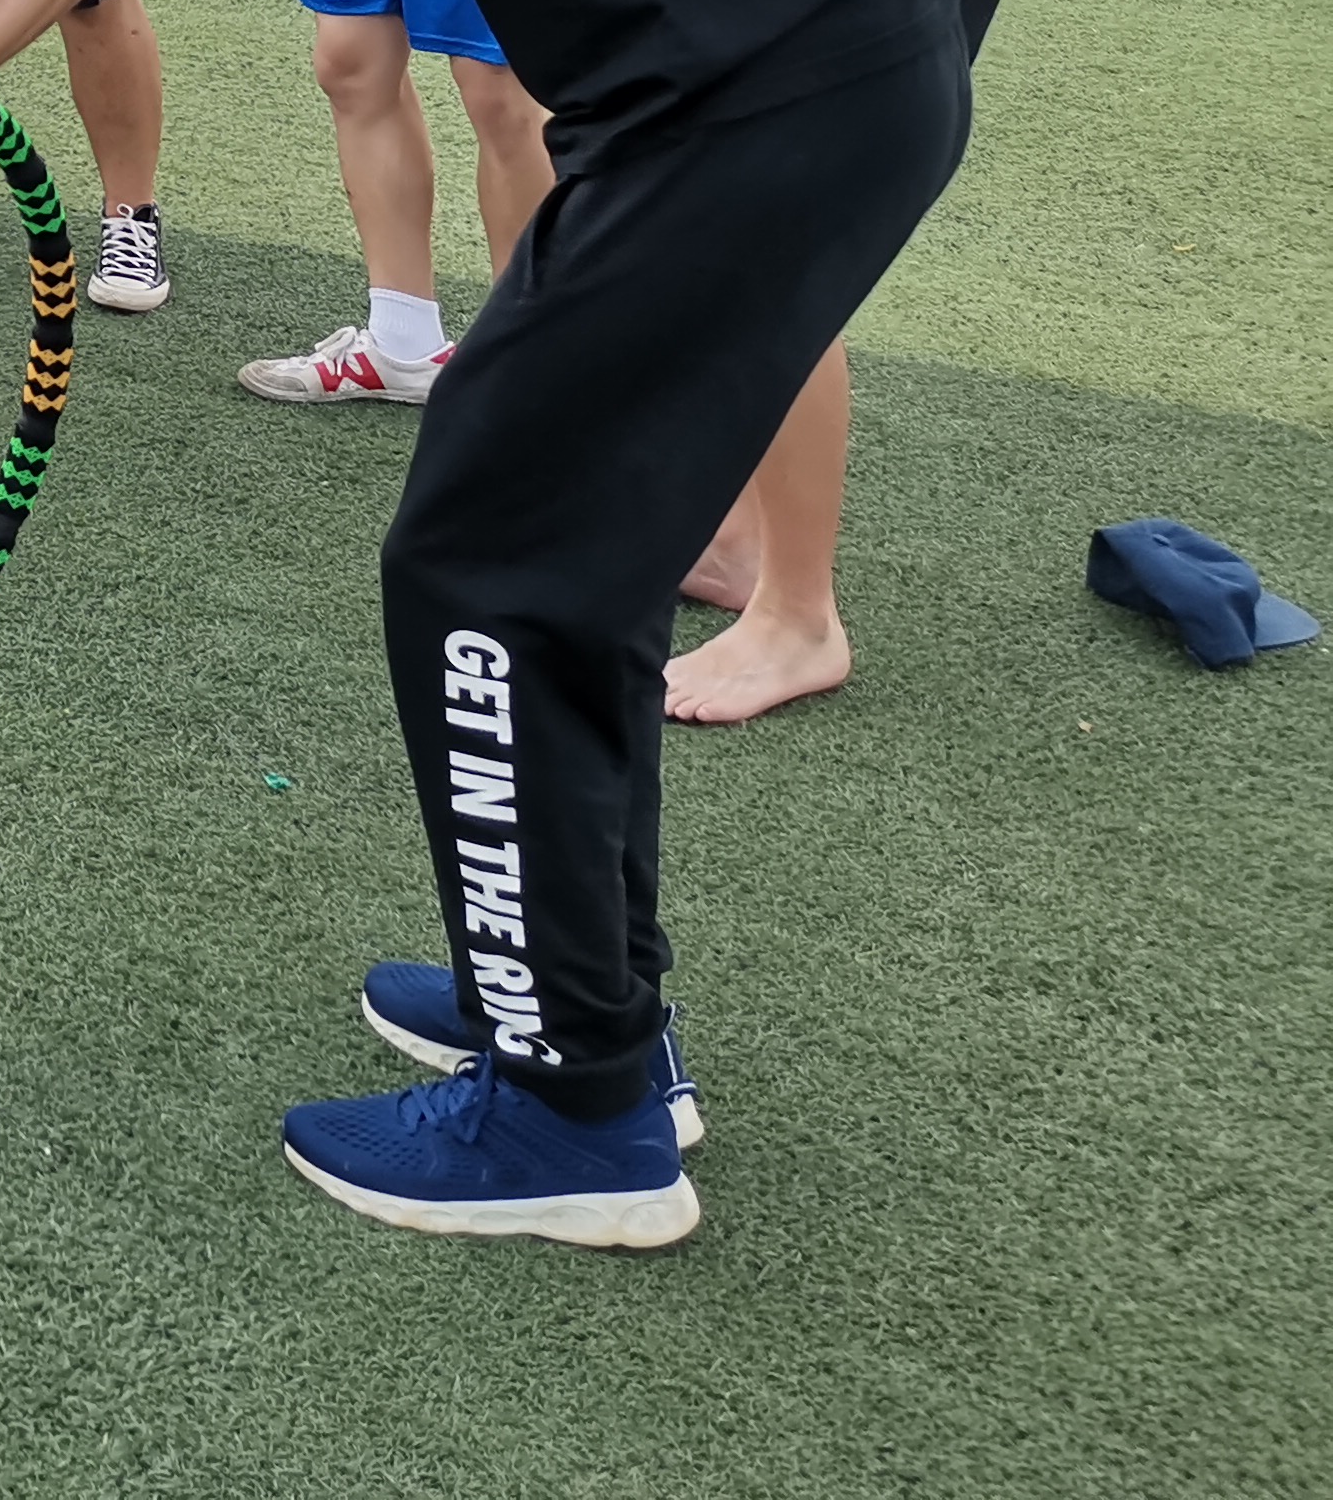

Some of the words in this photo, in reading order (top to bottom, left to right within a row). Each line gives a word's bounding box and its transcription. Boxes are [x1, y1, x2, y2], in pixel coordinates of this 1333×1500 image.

[444, 629, 515, 745] GET
[448, 749, 518, 824] IN
[456, 838, 527, 949] THE
[468, 947, 563, 1067] RING
